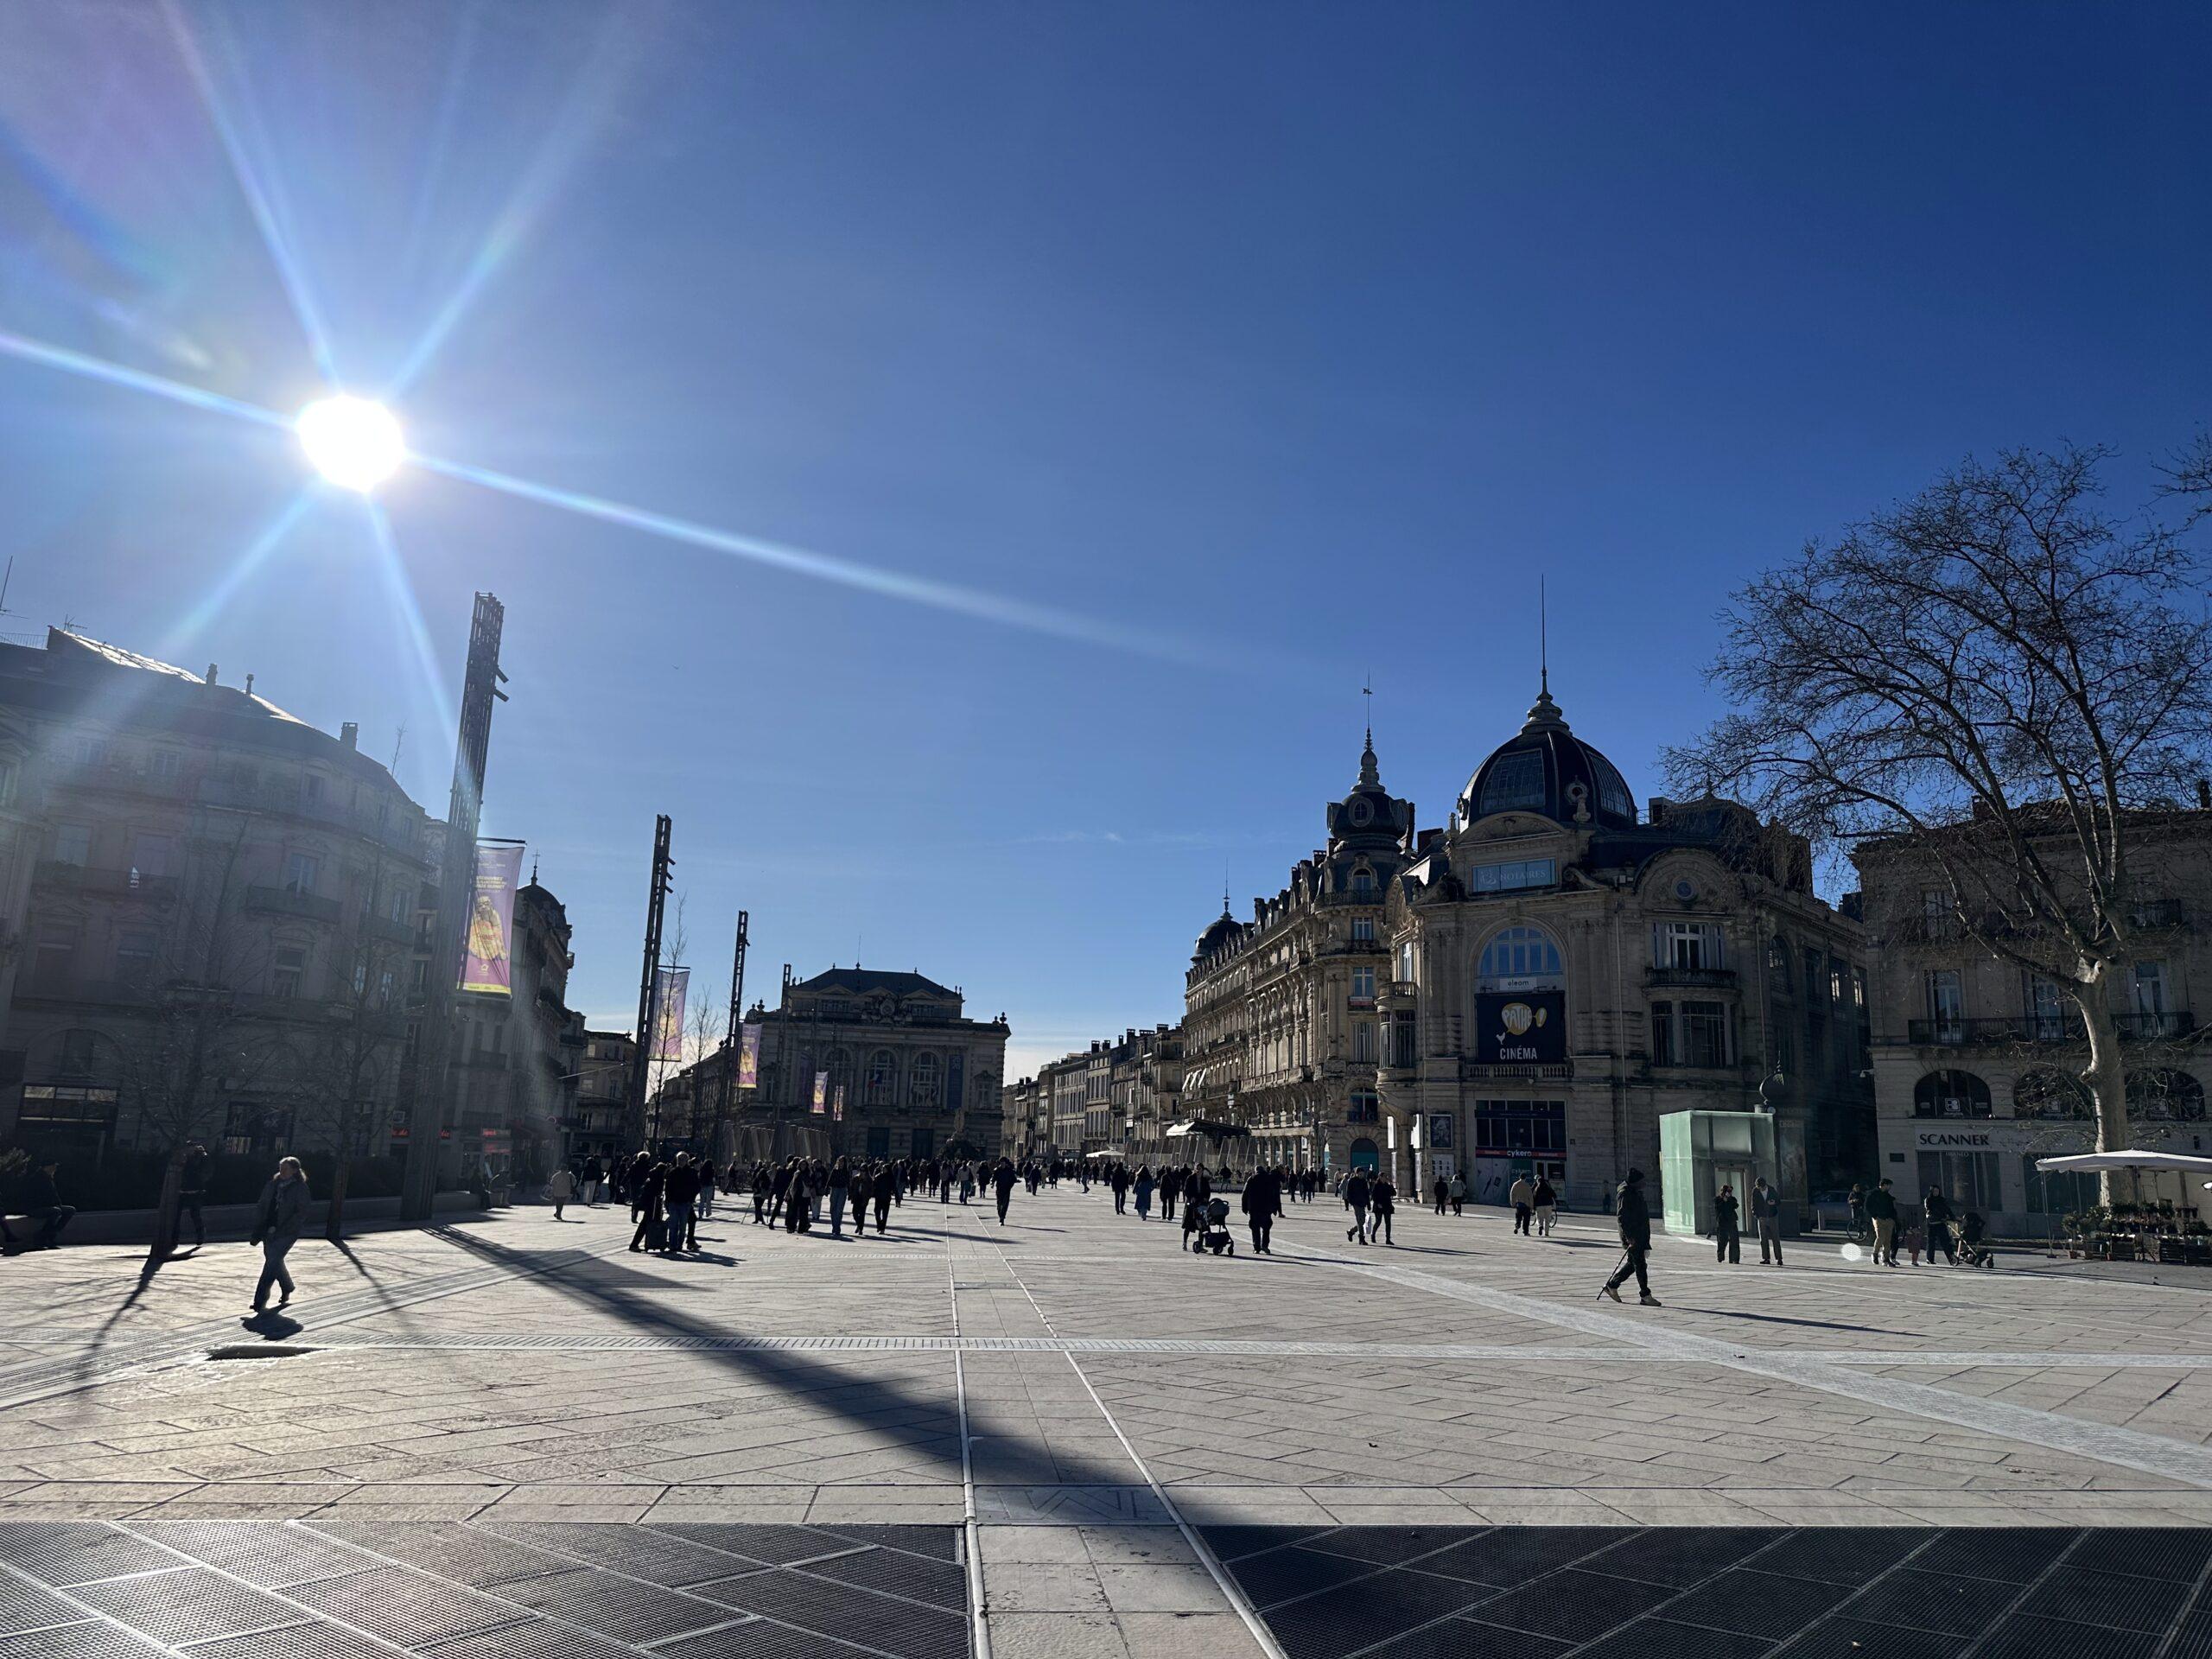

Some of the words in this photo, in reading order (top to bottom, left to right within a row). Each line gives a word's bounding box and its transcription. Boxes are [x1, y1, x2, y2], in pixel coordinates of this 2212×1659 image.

[1500, 869, 1547, 881] NOTAIRES
[1500, 1045, 1538, 1060] CINÉMA
[1919, 1134, 1990, 1146] SCANNER
